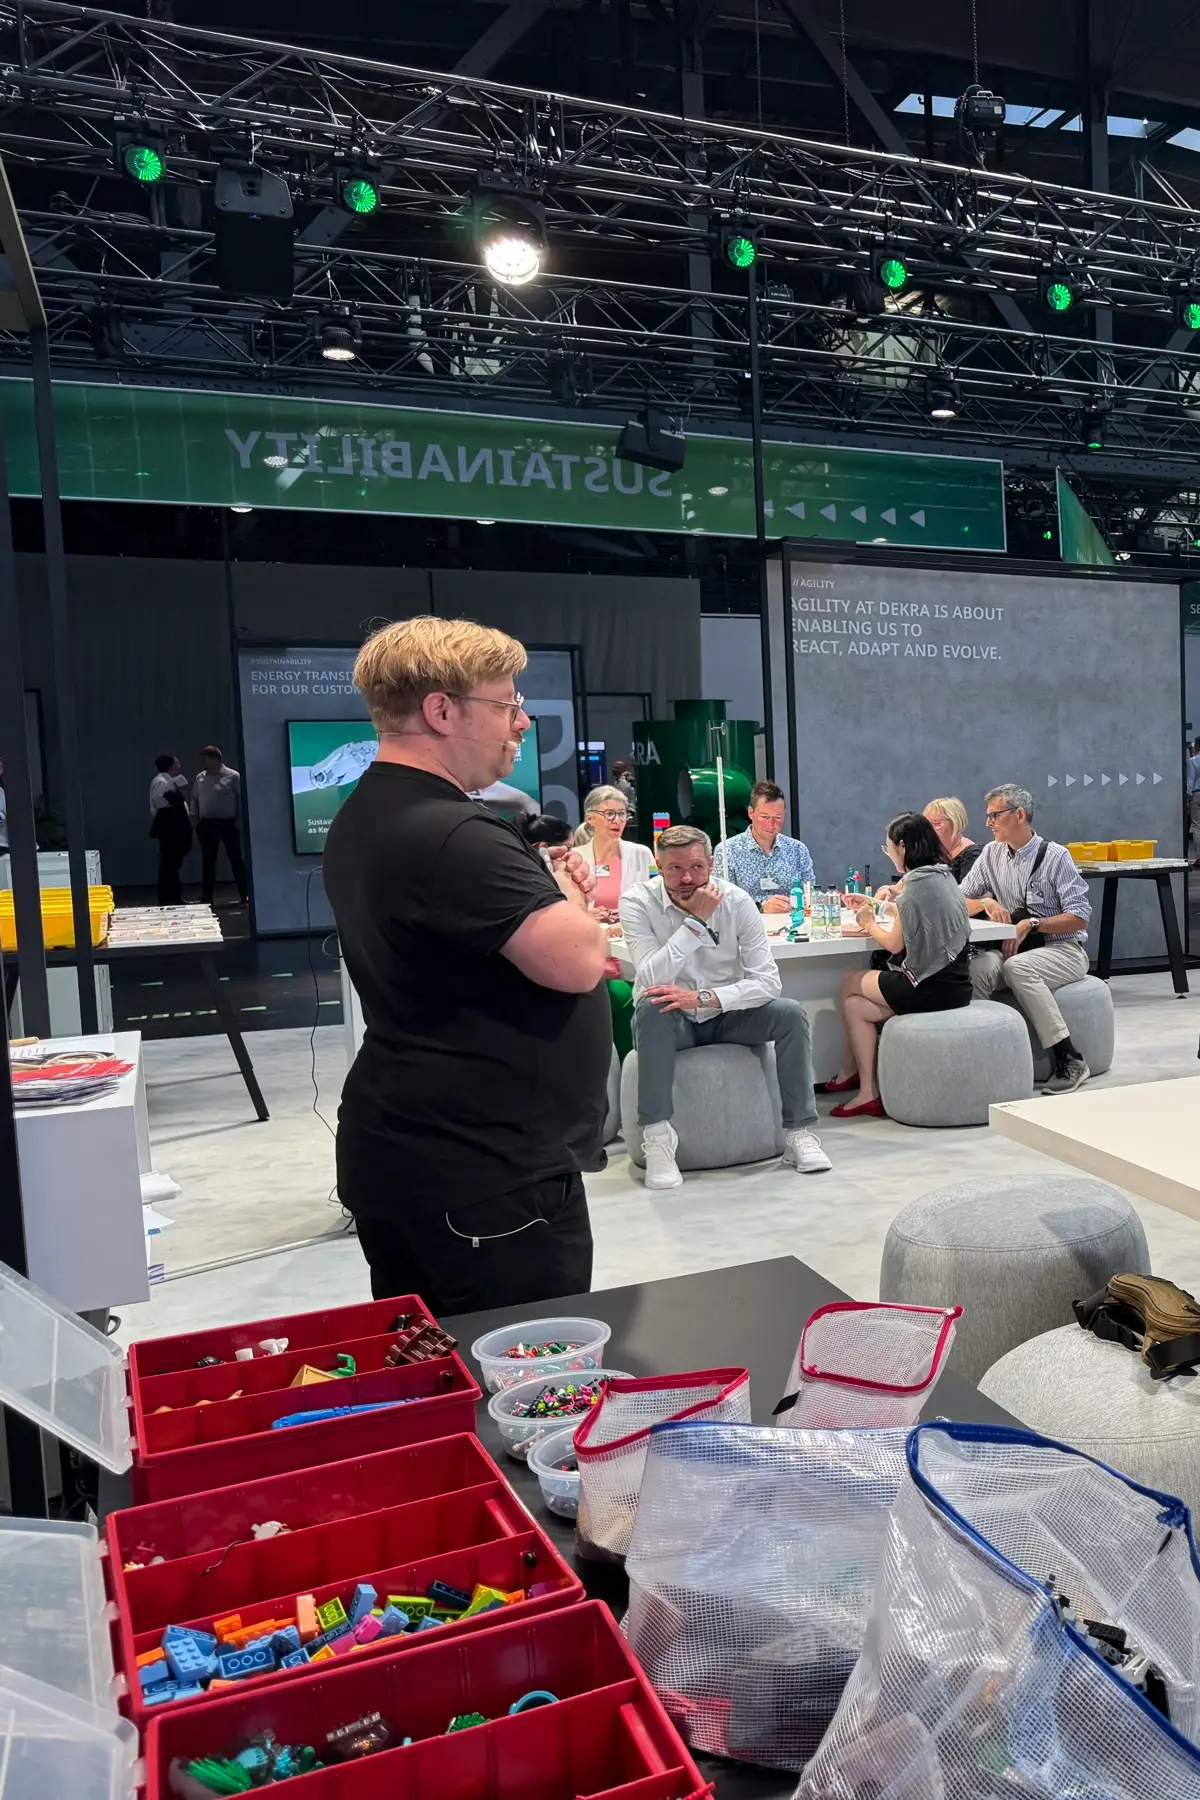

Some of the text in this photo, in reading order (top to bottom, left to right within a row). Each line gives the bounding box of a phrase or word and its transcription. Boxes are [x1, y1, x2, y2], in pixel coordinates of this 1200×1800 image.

[855, 601, 875, 614] AT
[879, 602, 930, 617] DEKRA
[933, 604, 949, 618] IS
[952, 606, 1004, 621] ABOUT
[792, 618, 923, 637] ENABLING US TO
[792, 639, 1003, 660] REACT, ADAPT AND EVOLVE.
[251, 671, 301, 681] ENERGY
[252, 684, 278, 695] FOR
[281, 684, 309, 695] OUR
